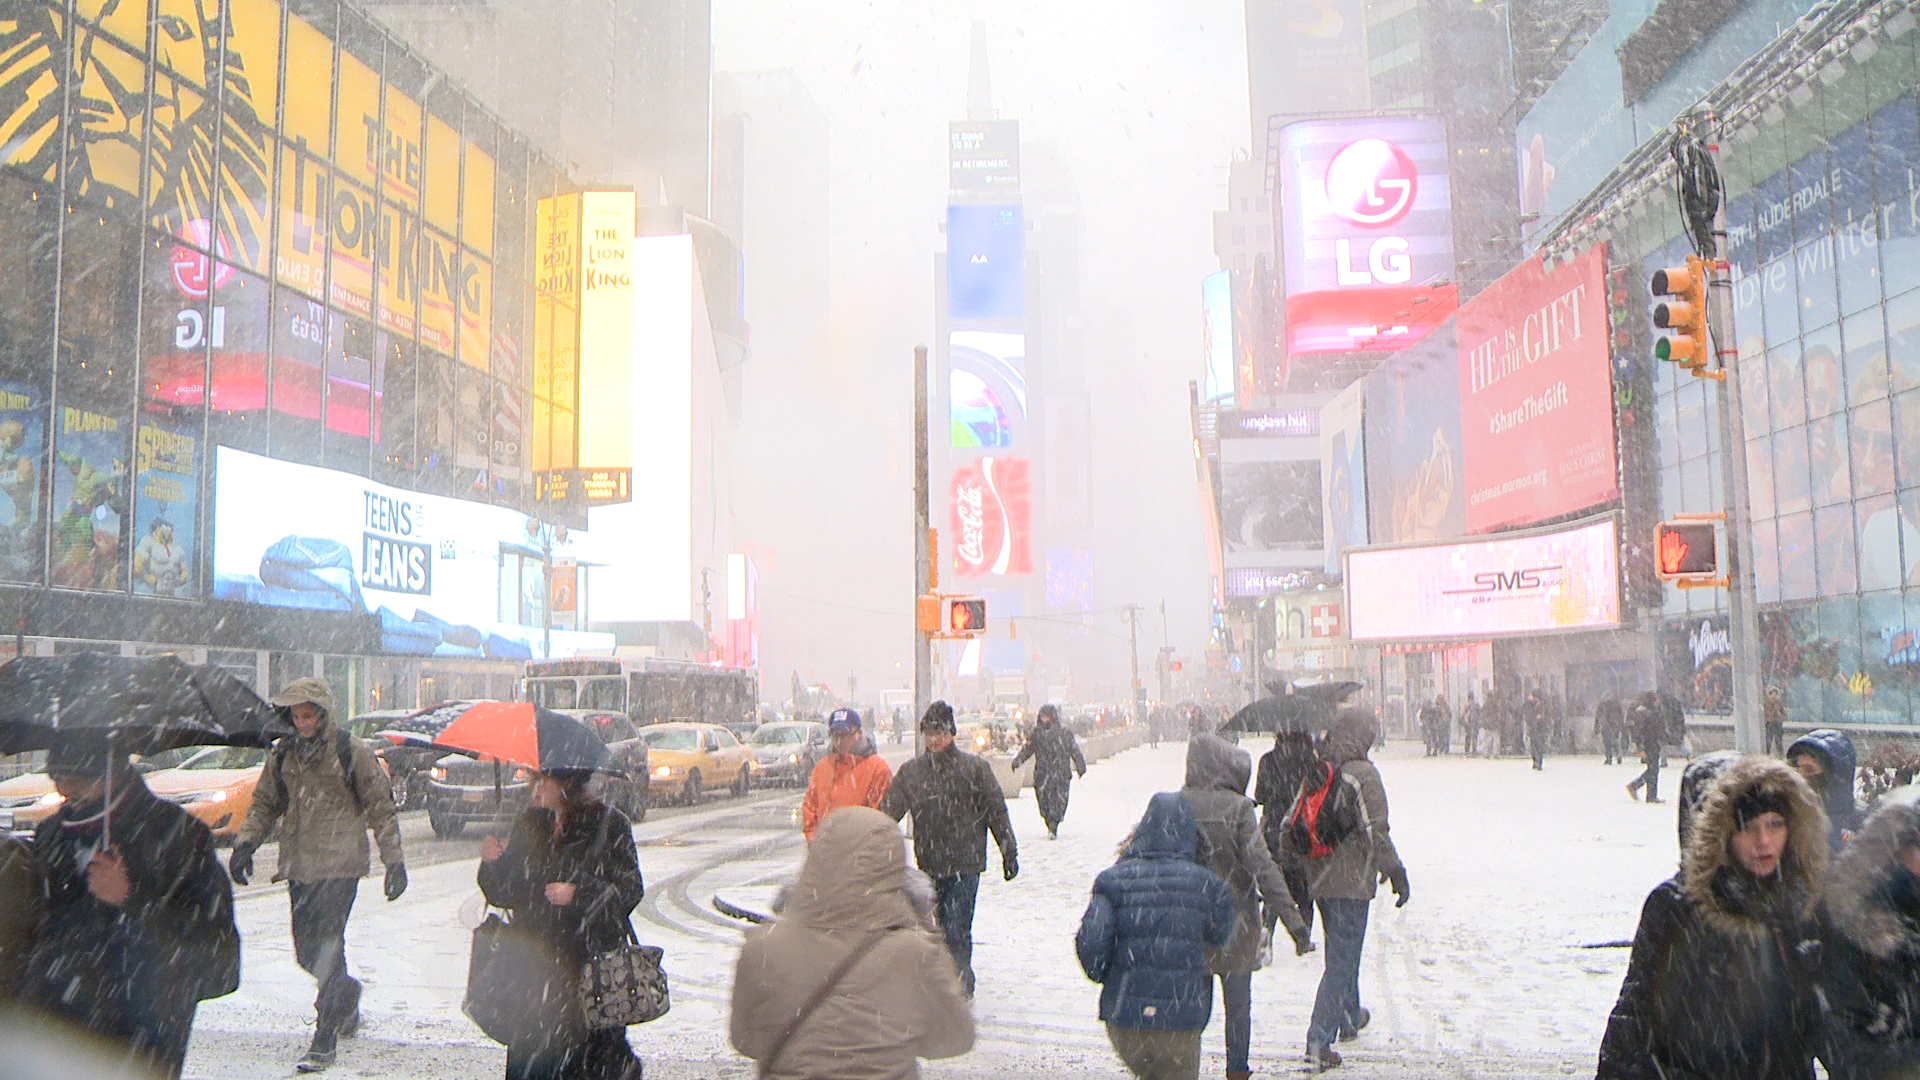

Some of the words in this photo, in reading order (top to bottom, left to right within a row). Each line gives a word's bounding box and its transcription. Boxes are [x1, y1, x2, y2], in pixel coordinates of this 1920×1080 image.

[363, 112, 418, 190] THE
[292, 135, 391, 268] LION
[396, 199, 481, 314] KING
[1748, 166, 1844, 240] LAUDERDALE
[589, 244, 625, 264] LION
[595, 229, 618, 240] THE
[1335, 236, 1413, 286] LG
[1796, 200, 1897, 281] winter
[586, 267, 630, 291] KING
[333, 285, 371, 313] ENTRANCE
[380, 308, 392, 322] ON
[420, 326, 442, 344] STREET
[1504, 325, 1517, 351] IS
[1523, 282, 1586, 365] GIFT
[1469, 335, 1501, 395] HE
[1501, 345, 1525, 378] THE
[1489, 382, 1568, 435] #ShareTheGift
[363, 489, 413, 536] TEENS
[956, 482, 984, 565] Coca-Cola
[362, 536, 427, 591] JEANS
